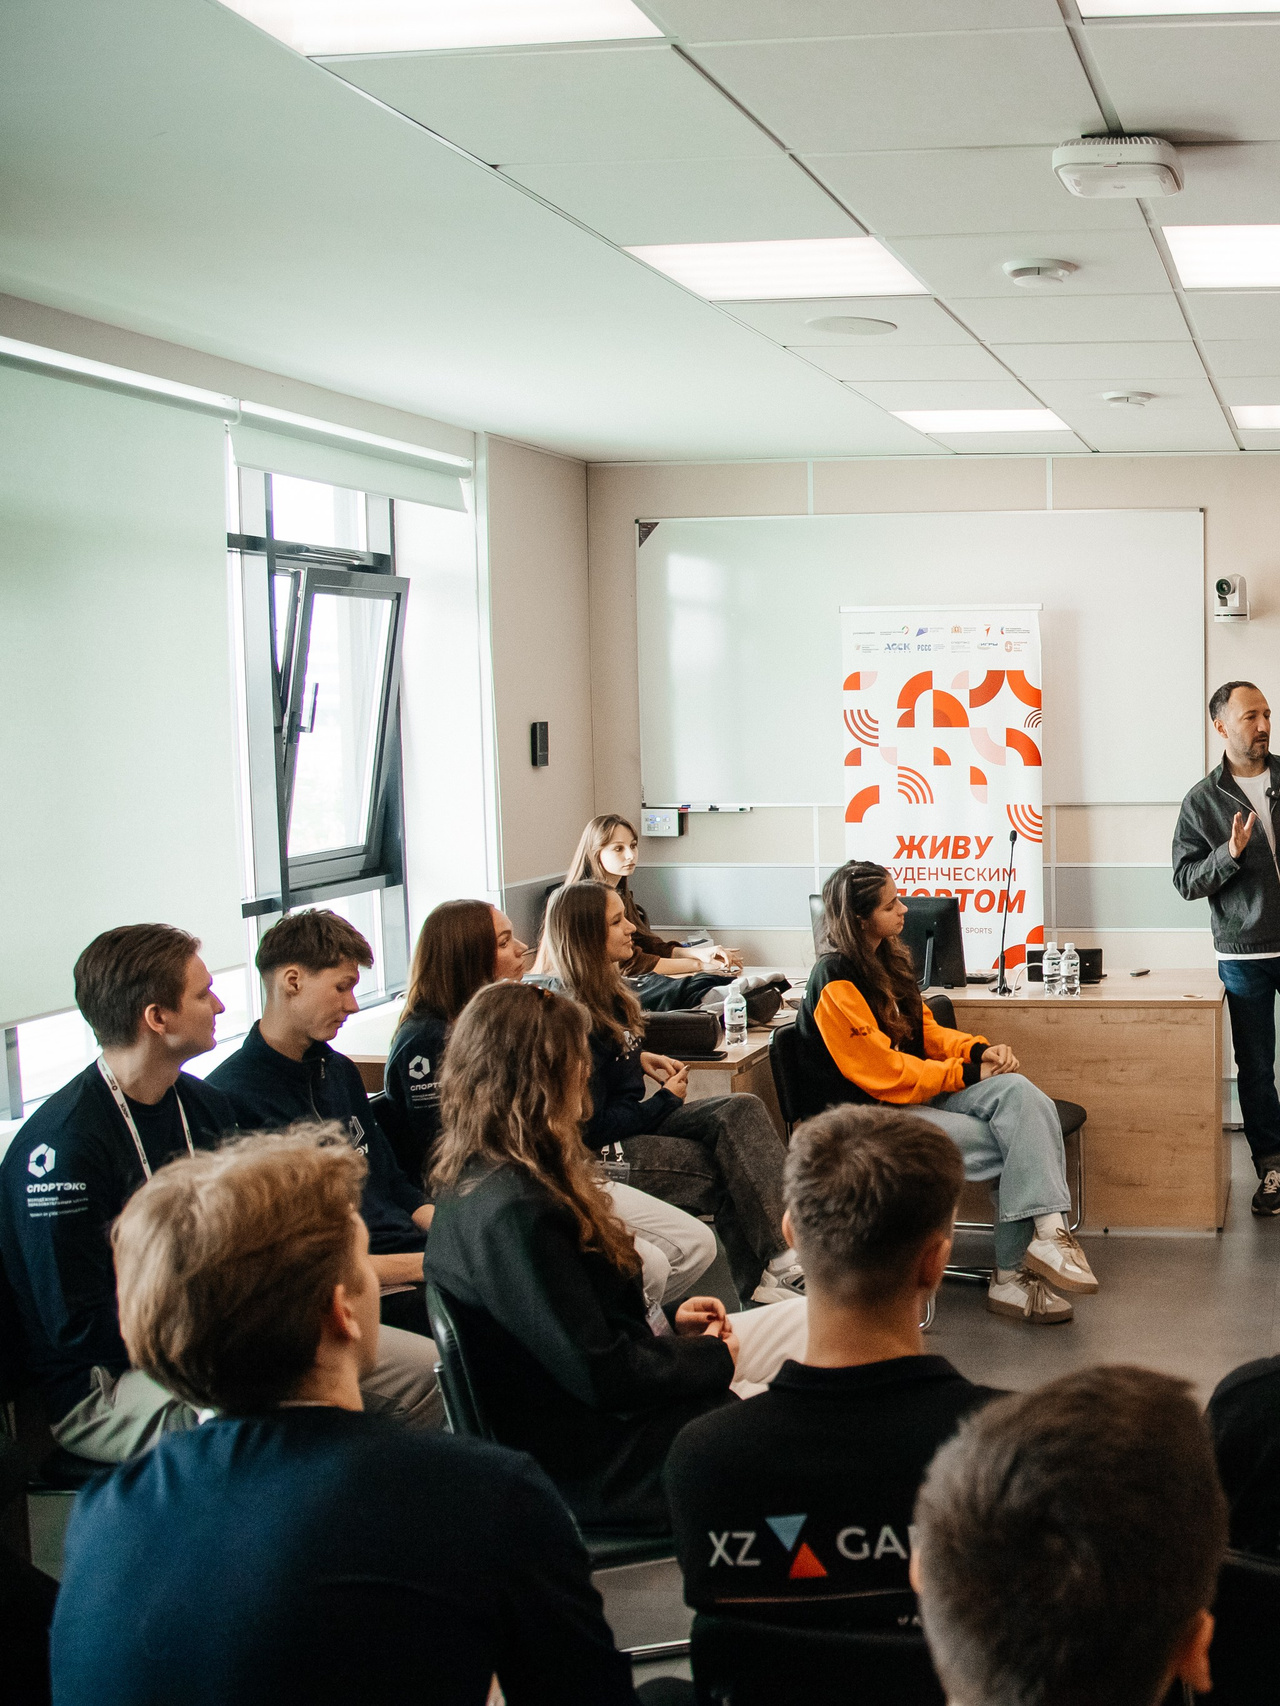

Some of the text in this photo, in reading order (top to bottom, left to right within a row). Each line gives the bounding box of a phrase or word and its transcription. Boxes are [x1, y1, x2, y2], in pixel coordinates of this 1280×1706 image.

[892, 835, 994, 859] ЖИВУ
[885, 866, 1017, 884] УДЕНЧЕСКИМ
[965, 926, 993, 934] SPORTS
[410, 1081, 442, 1092] СПОРТ
[26, 1181, 87, 1194] СПОРТЭКС
[708, 1524, 917, 1568] XZ GA
